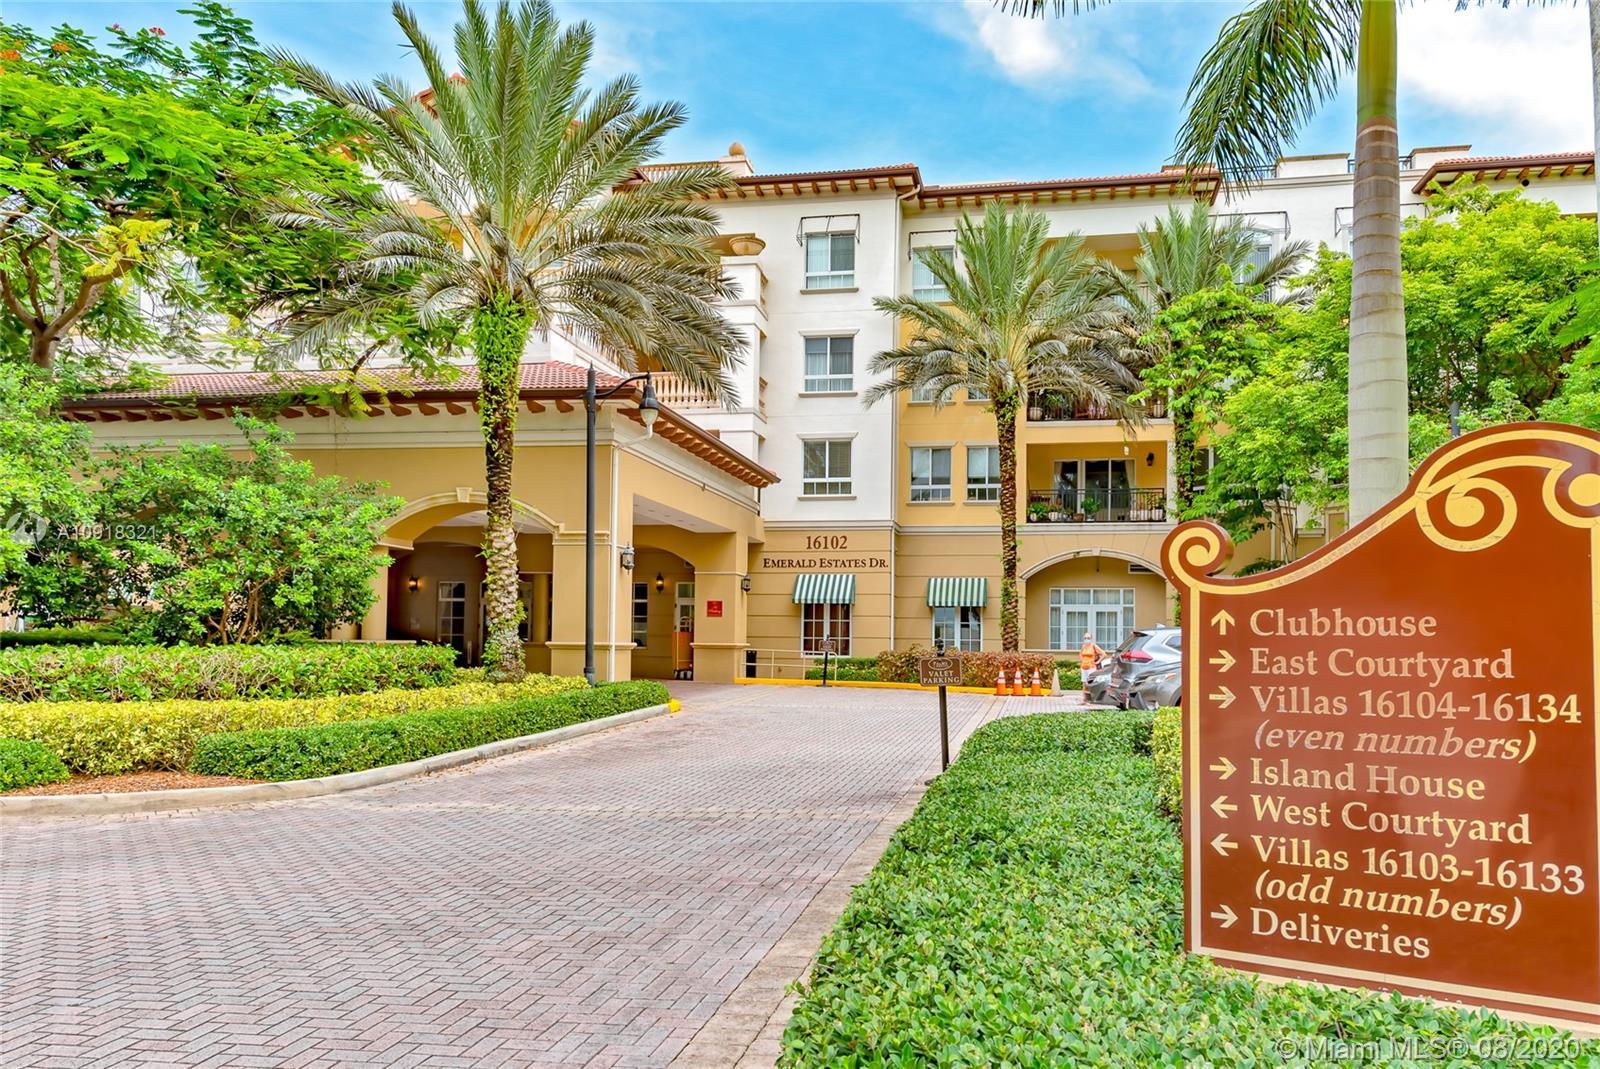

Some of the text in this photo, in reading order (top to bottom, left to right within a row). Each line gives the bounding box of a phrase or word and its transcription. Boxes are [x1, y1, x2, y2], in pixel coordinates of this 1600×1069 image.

[763, 557, 817, 568] EMERALD
[818, 557, 867, 568] ESTATES
[805, 535, 848, 550] 16102
[1249, 608, 1438, 637] Clubhouse
[1250, 648, 1515, 687] East Courtyard
[1250, 686, 1582, 724] Villas 16104-16134
[1255, 720, 1537, 764] (even numbers)
[1250, 757, 1486, 801] Island House
[1251, 794, 1532, 848] West Courtyard
[1251, 834, 1586, 895] Villas 16103-16133
[1255, 869, 1522, 930] (odd numbers)
[1251, 907, 1431, 959] Deliveries
